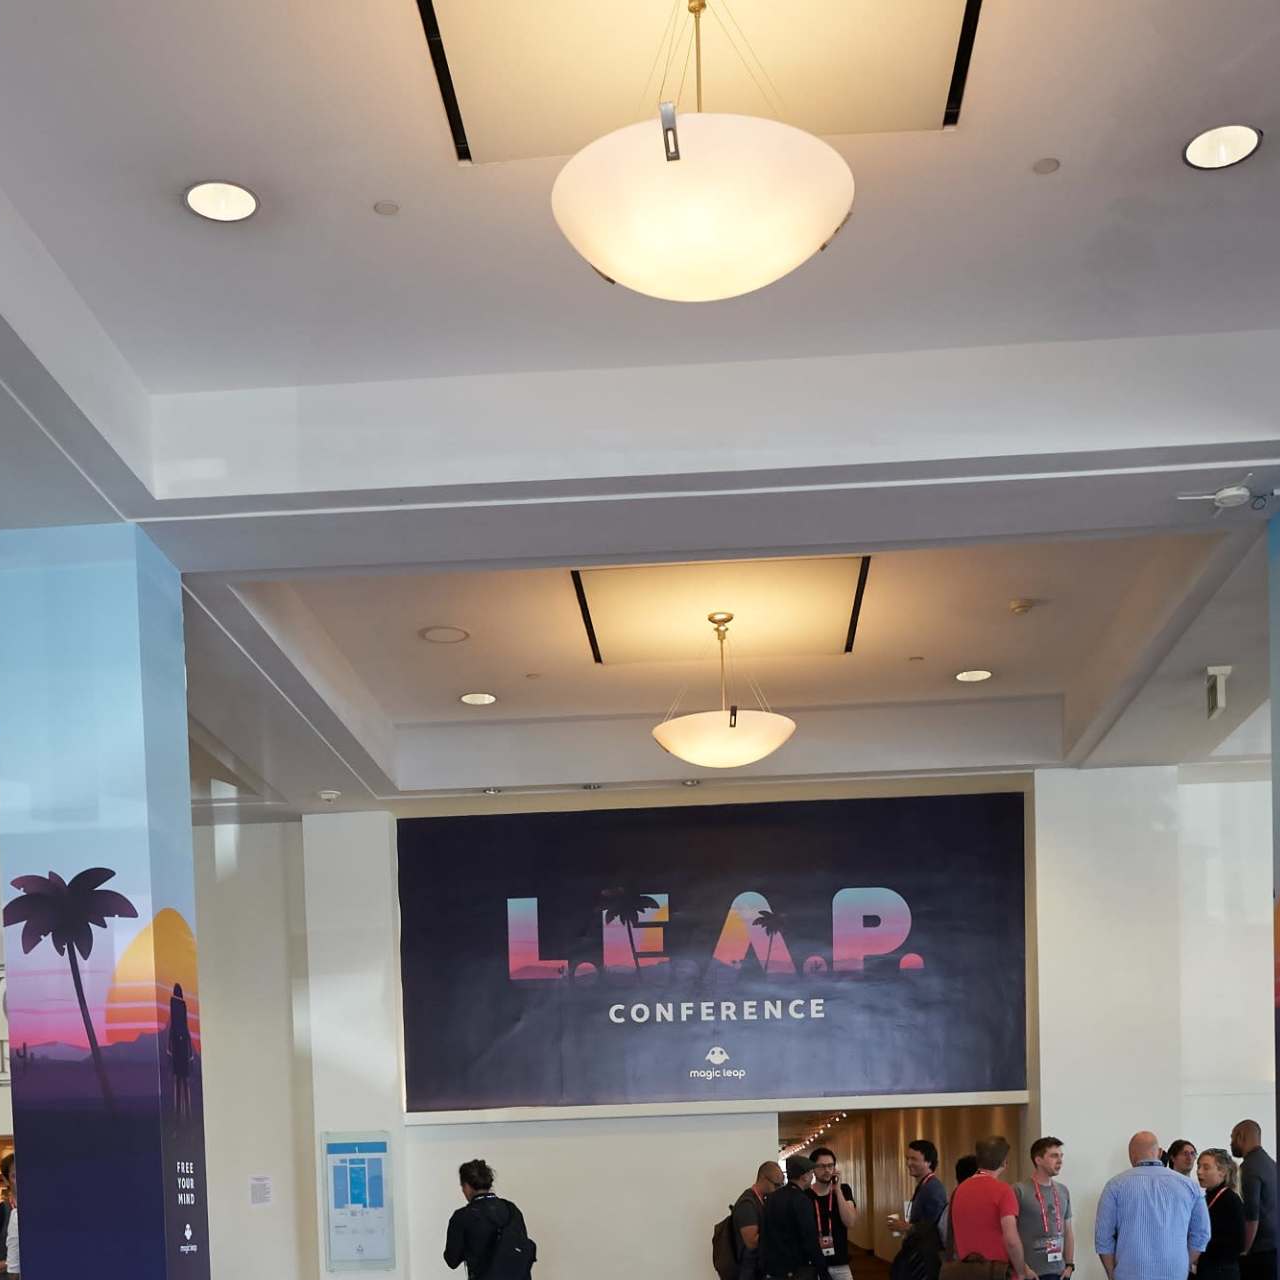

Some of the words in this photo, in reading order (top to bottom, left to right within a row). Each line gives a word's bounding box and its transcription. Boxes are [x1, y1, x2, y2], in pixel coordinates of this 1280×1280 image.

[506, 886, 926, 981] L.E.A.P.
[608, 998, 825, 1024] CONFERENCE
[689, 1067, 720, 1080] magic
[722, 1068, 746, 1080] leap
[176, 1161, 194, 1174] FREE
[177, 1177, 195, 1190] YOUR
[178, 1193, 195, 1205] MIND
